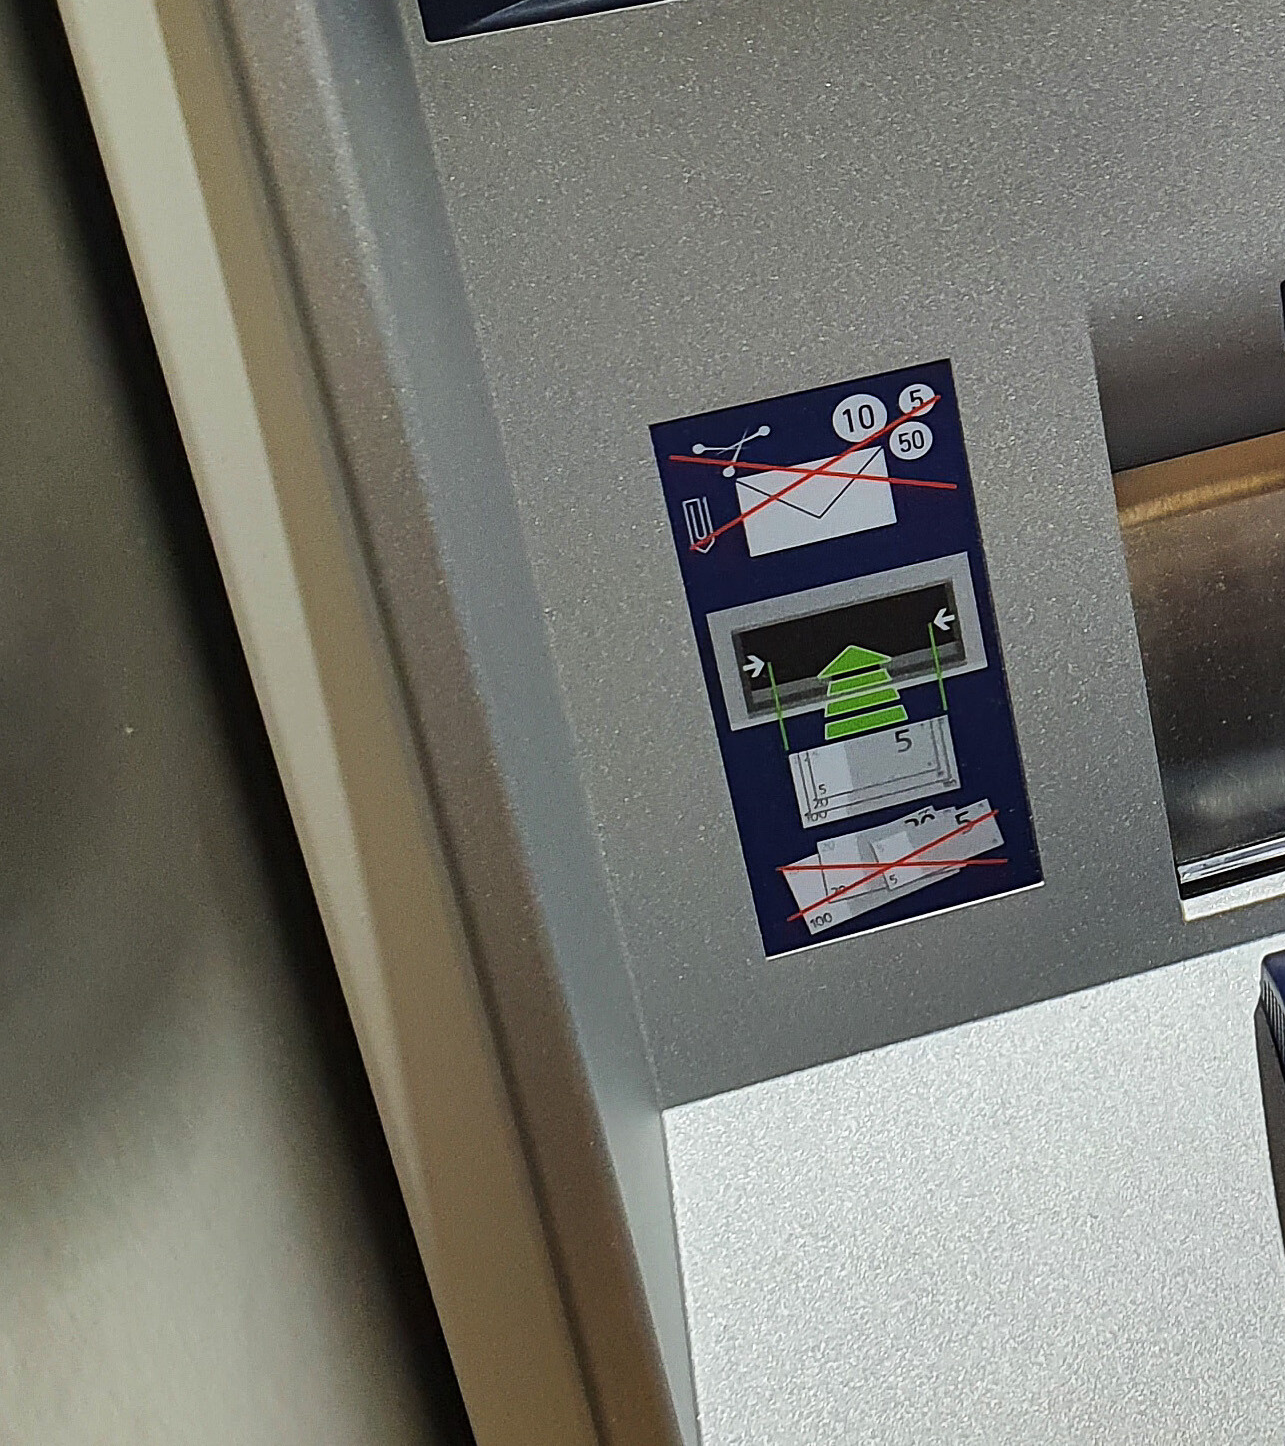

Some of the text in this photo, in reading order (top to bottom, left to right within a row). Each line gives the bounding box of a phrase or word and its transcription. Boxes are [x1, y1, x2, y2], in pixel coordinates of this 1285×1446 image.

[909, 388, 924, 410] 5
[841, 404, 875, 433] 10
[898, 428, 926, 454] 50
[894, 729, 912, 753] 5
[818, 783, 827, 795] 5
[889, 874, 898, 884] 5
[810, 913, 832, 928] 100
